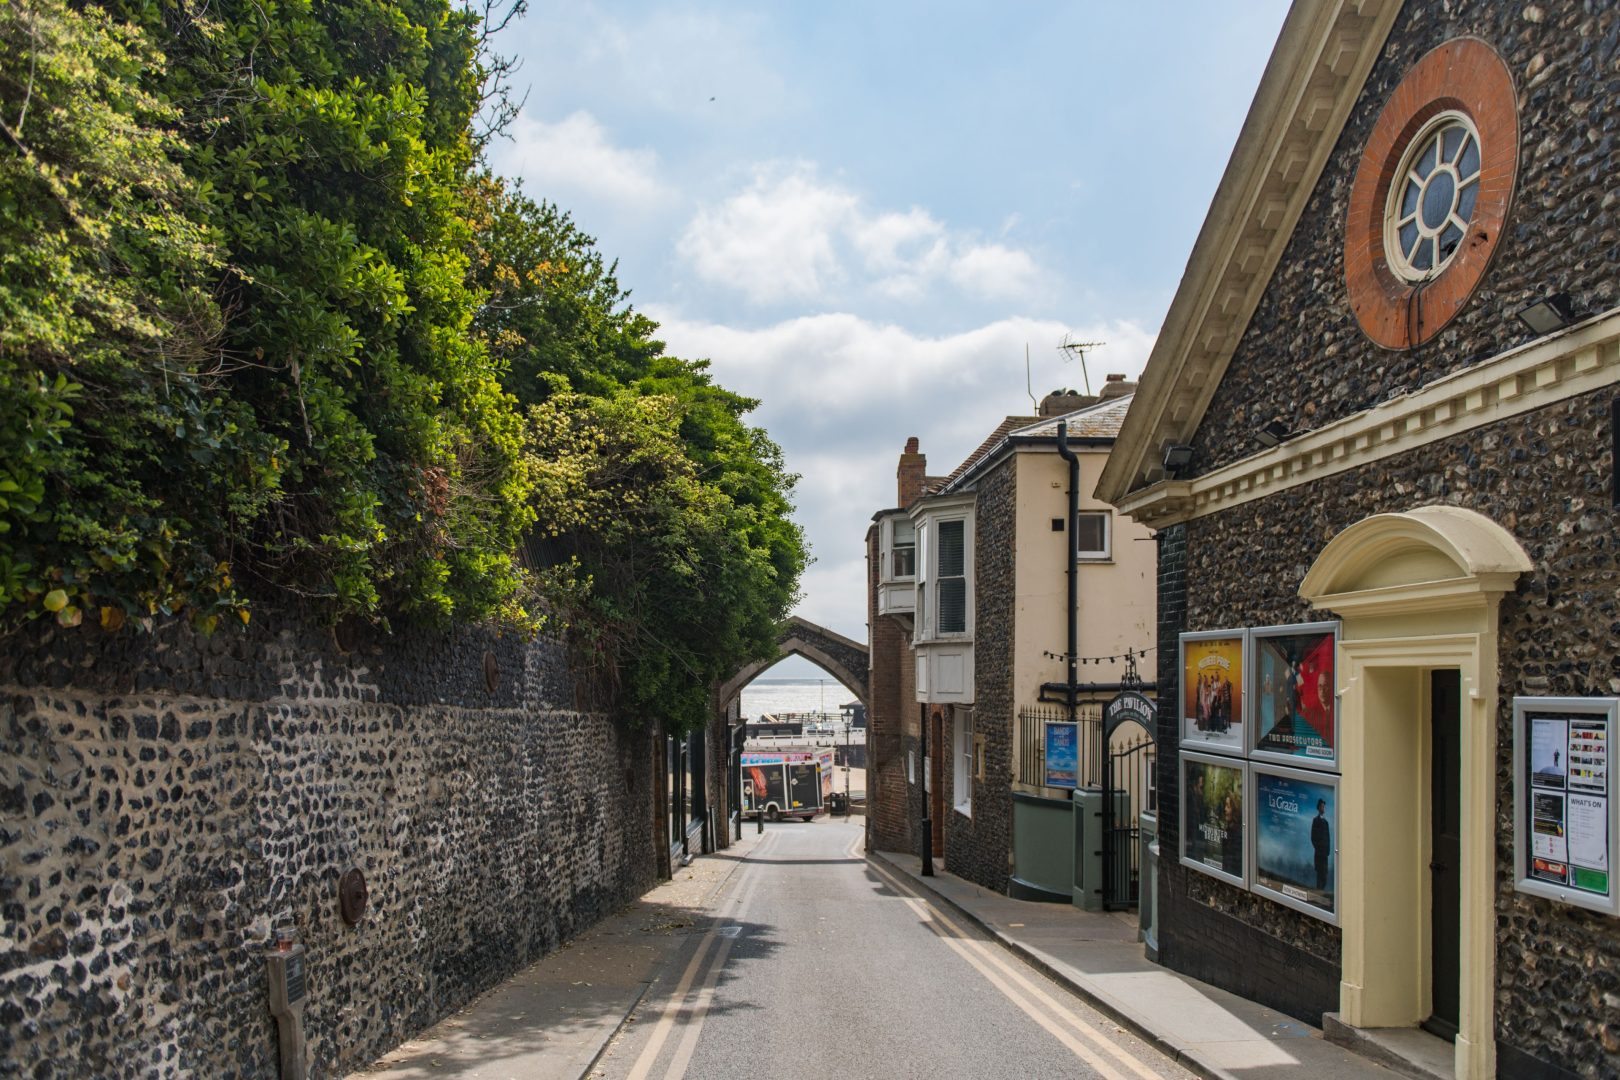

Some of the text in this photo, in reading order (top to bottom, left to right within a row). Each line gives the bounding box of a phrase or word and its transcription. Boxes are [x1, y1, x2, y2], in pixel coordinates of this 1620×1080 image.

[1109, 699, 1122, 717] THE
[1123, 697, 1153, 721] PAVILION
[1268, 733, 1322, 747] TWO PROSECUTORS
[1269, 793, 1298, 813] La Grazia
[1570, 798, 1592, 807] WHAT'S
